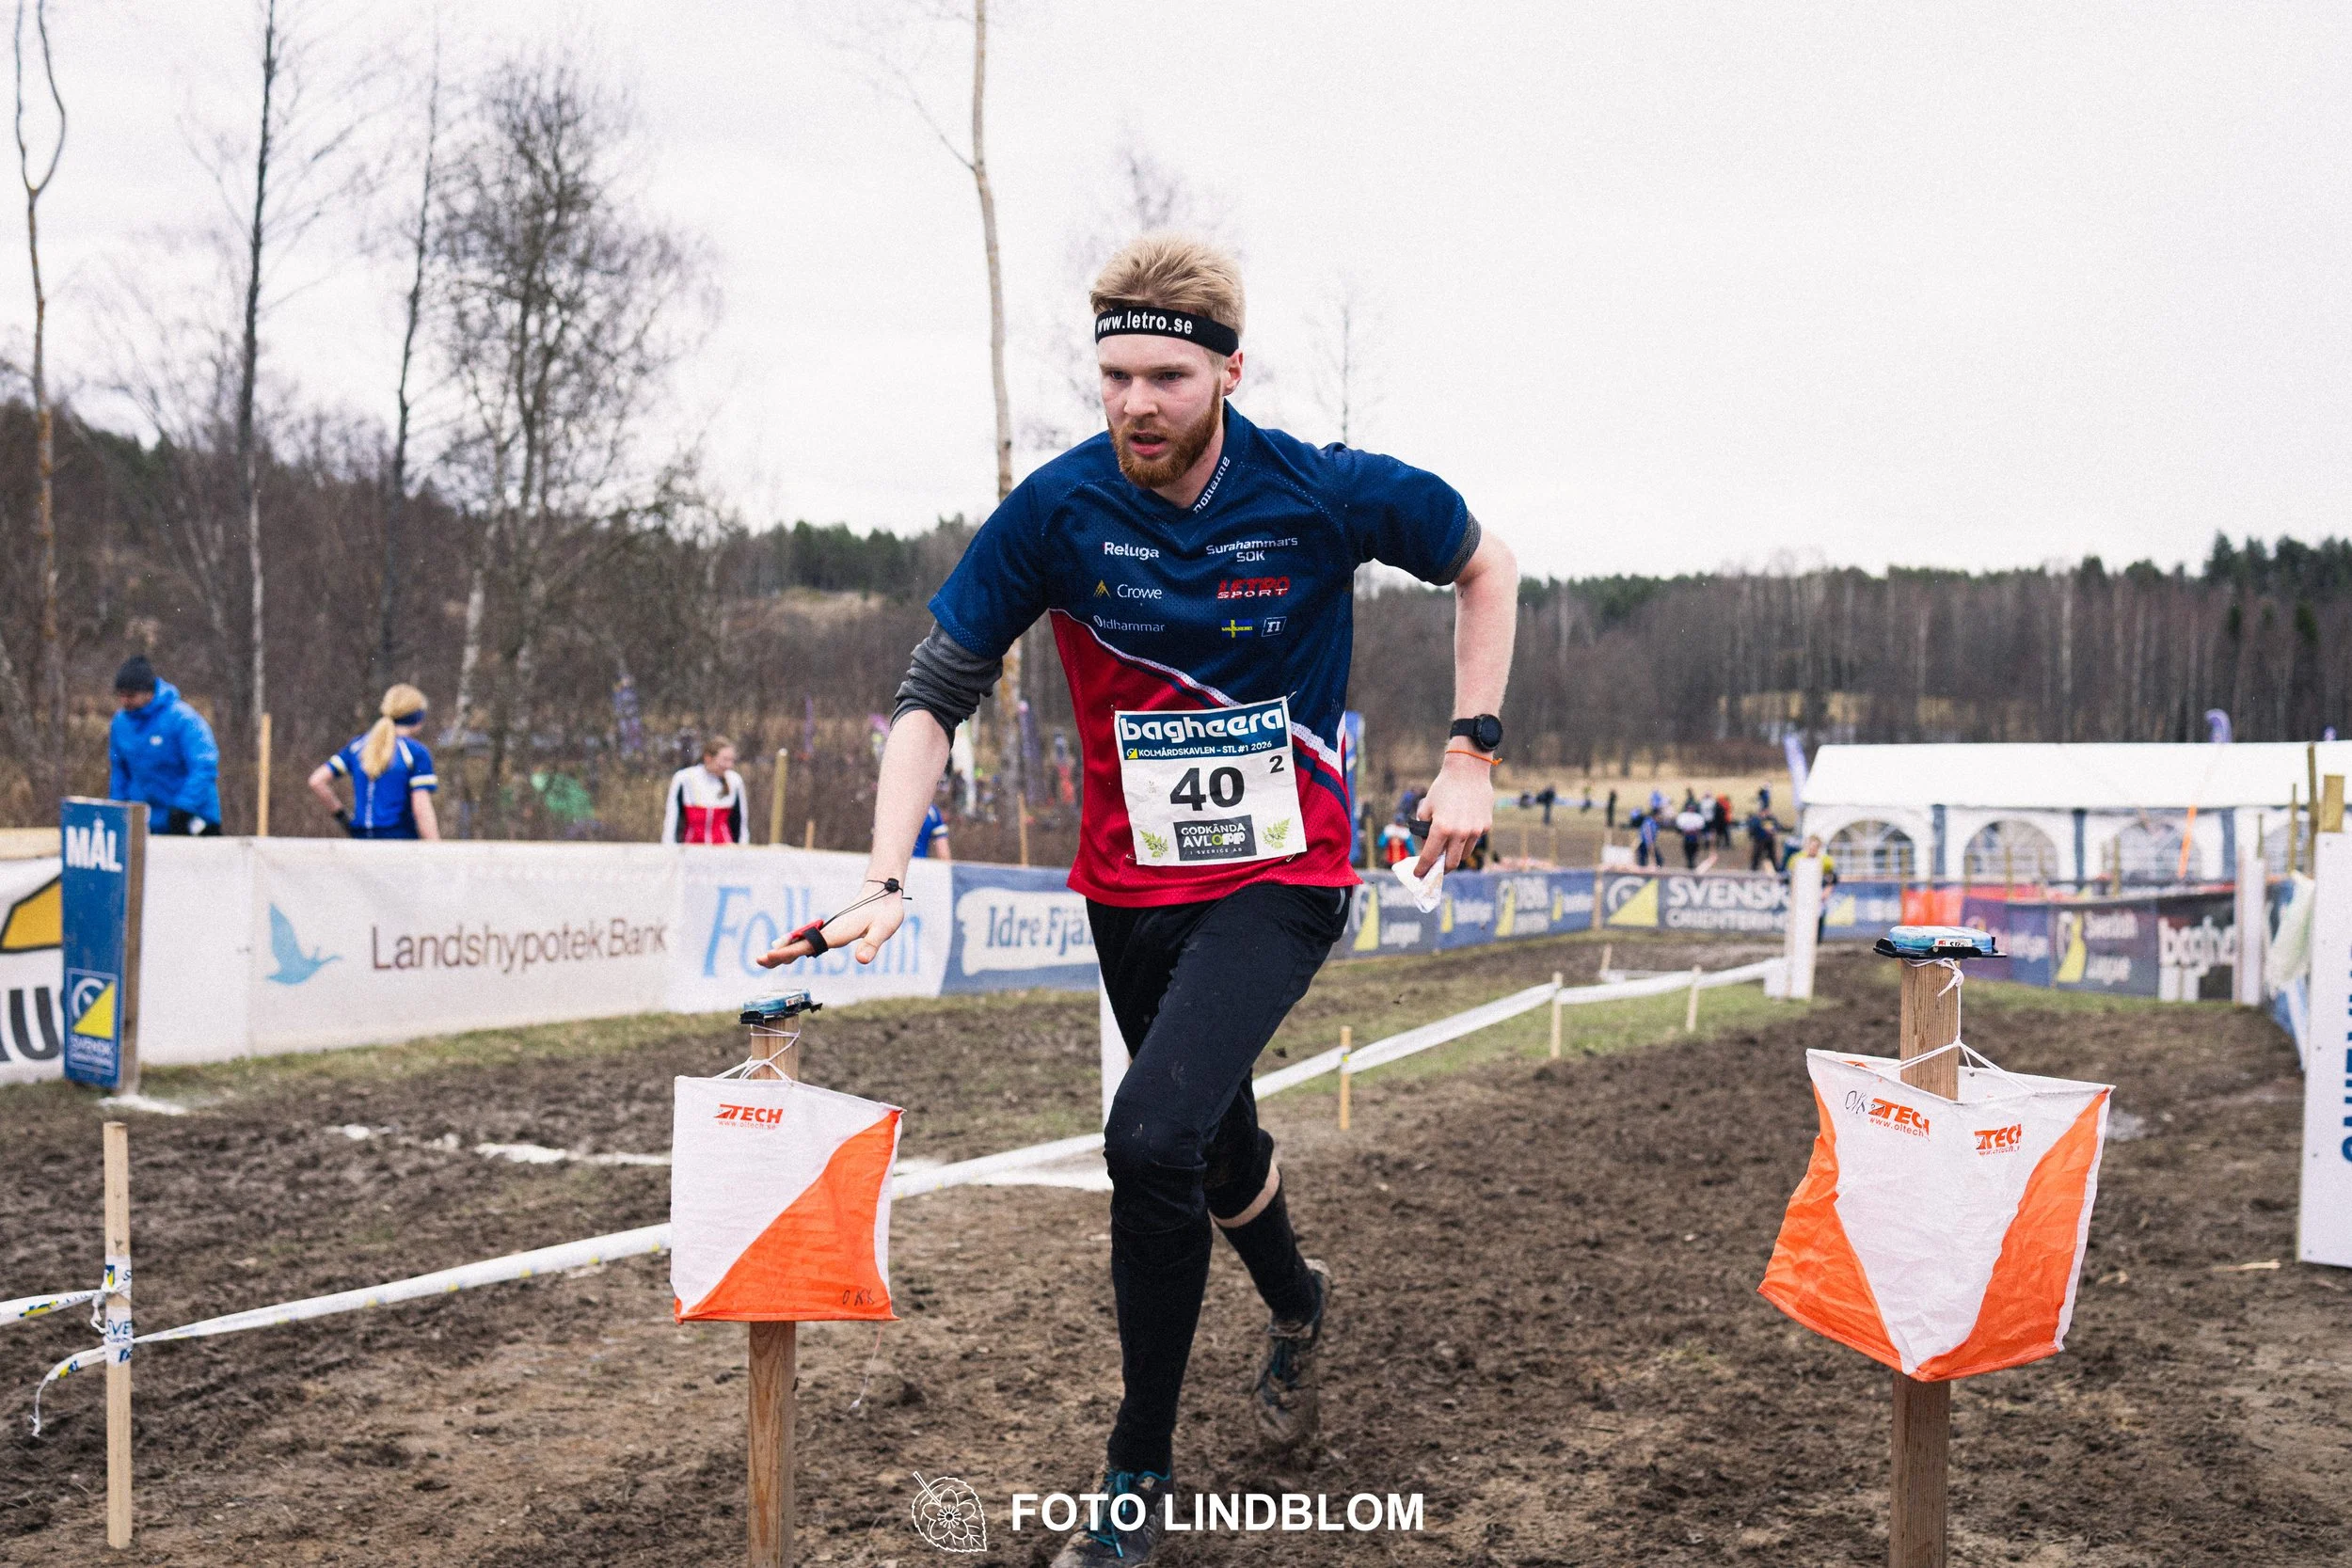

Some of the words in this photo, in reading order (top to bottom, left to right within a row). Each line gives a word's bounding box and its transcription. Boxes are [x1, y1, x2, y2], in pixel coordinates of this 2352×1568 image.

[1097, 310, 1193, 335] www.letro.se
[1193, 456, 1231, 514] noname
[1103, 541, 1160, 561] Reluga
[1206, 537, 1298, 555] Surahammars
[1236, 550, 1265, 562] SOK
[1117, 583, 1163, 599] Crowe
[1217, 588, 1288, 599] SPORT
[1093, 614, 1166, 632] Oldhammar
[1120, 708, 1285, 743] bagheera
[1138, 746, 1216, 757] KOLMÅRDSKAVLEN
[1251, 741, 1273, 751] 2026
[1269, 754, 1285, 773] 2
[1169, 766, 1246, 811] 40
[1181, 823, 1246, 835] GODKÄNDA
[66, 816, 123, 873] MÅL
[1666, 876, 1790, 909] SVENSK
[986, 905, 1041, 947] Idre
[1046, 906, 1093, 956] Fjä
[372, 919, 605, 974] Landshypotek
[608, 918, 669, 958] Bank
[1869, 1117, 1930, 1141] www.oltech.
